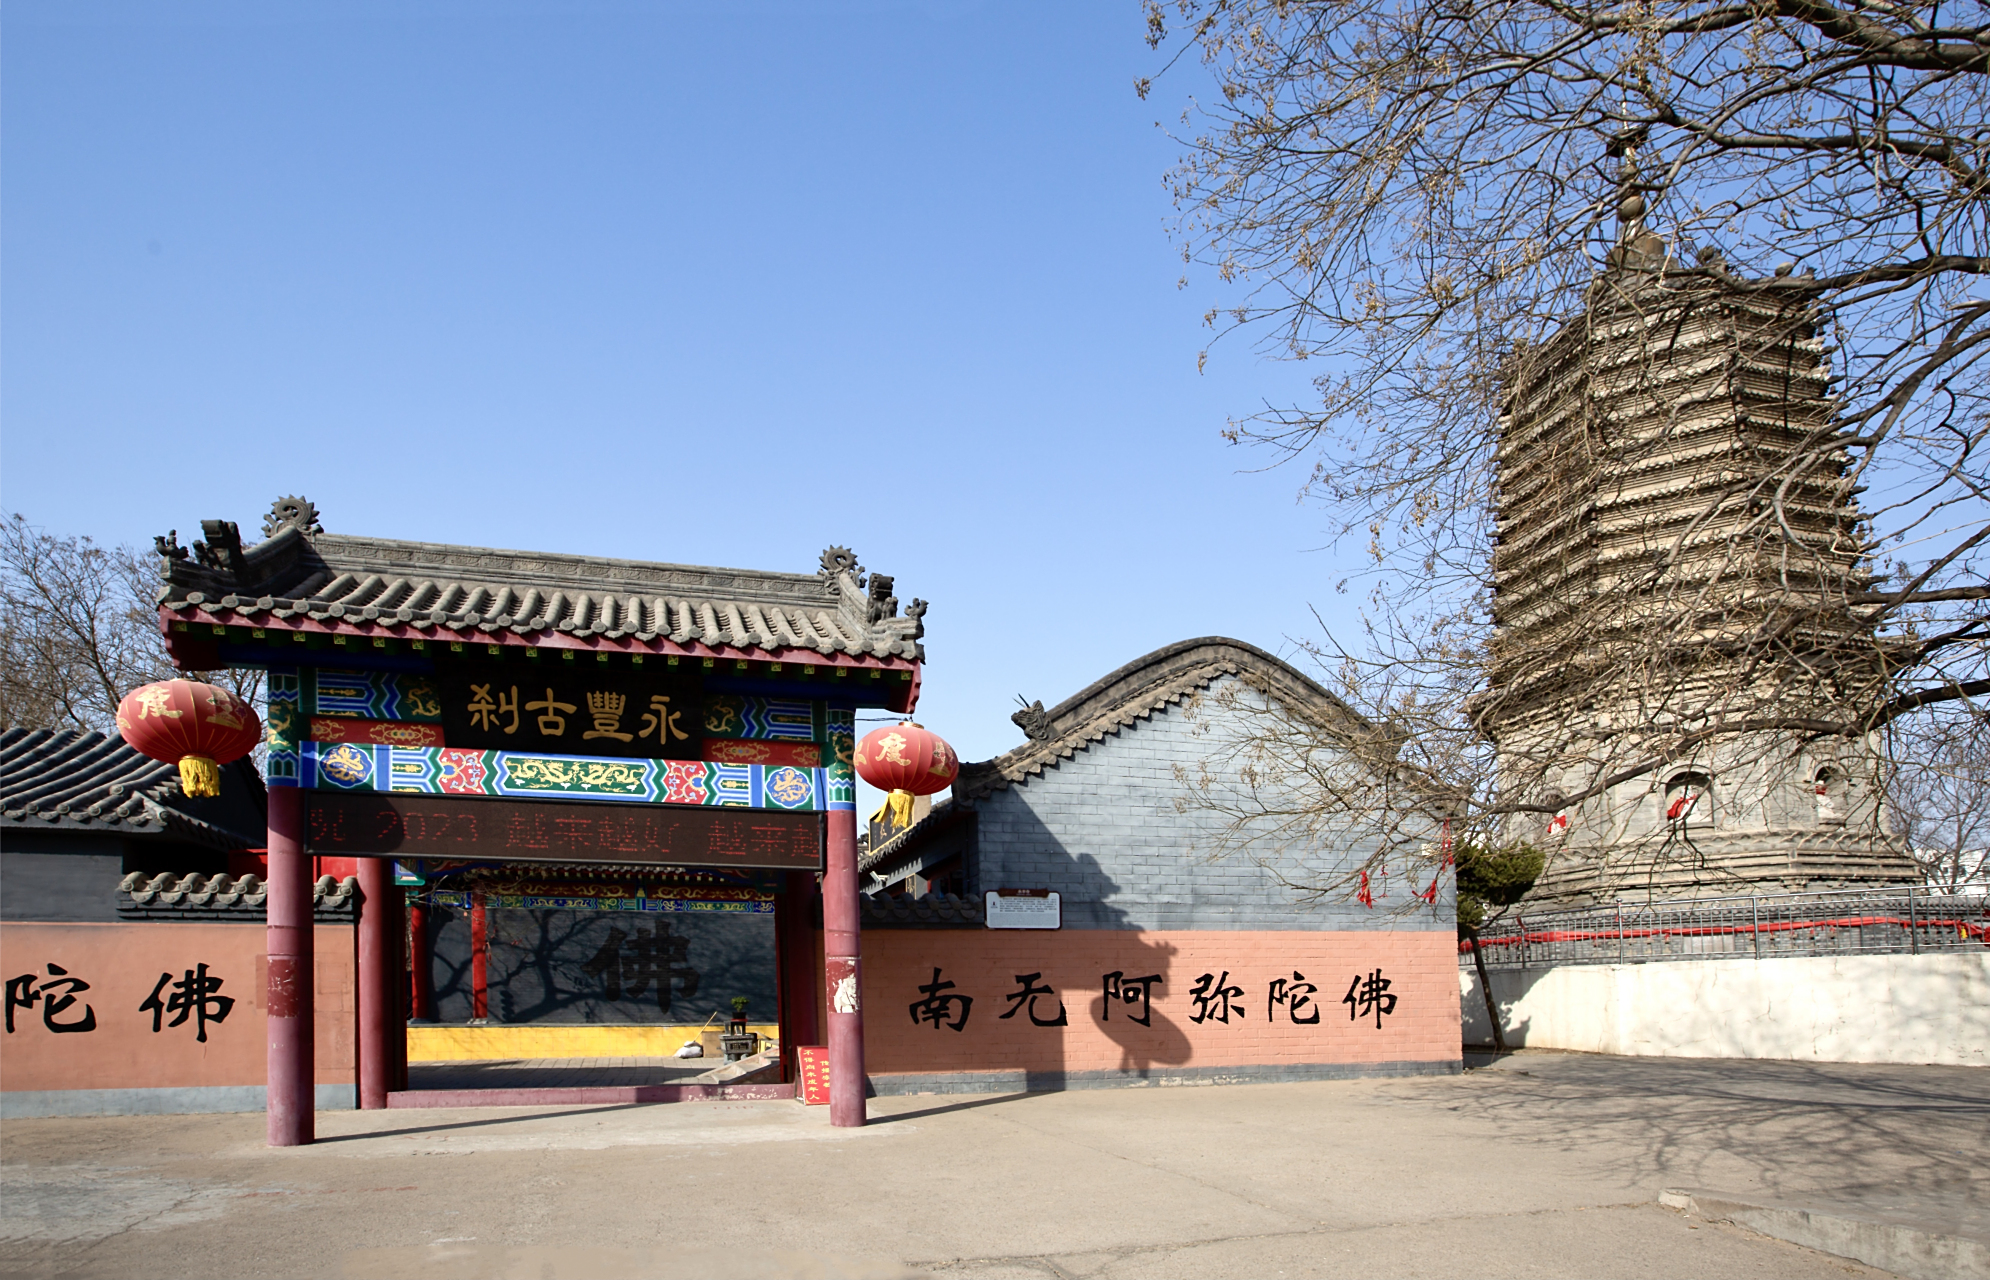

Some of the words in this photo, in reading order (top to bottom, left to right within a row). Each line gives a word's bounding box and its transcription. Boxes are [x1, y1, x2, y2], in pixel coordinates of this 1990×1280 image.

[376, 811, 479, 843] 2023
[5, 962, 236, 1043] 陀佛
[580, 919, 701, 1015] 佛
[908, 966, 1398, 1033] 南无阿弥陀佛
